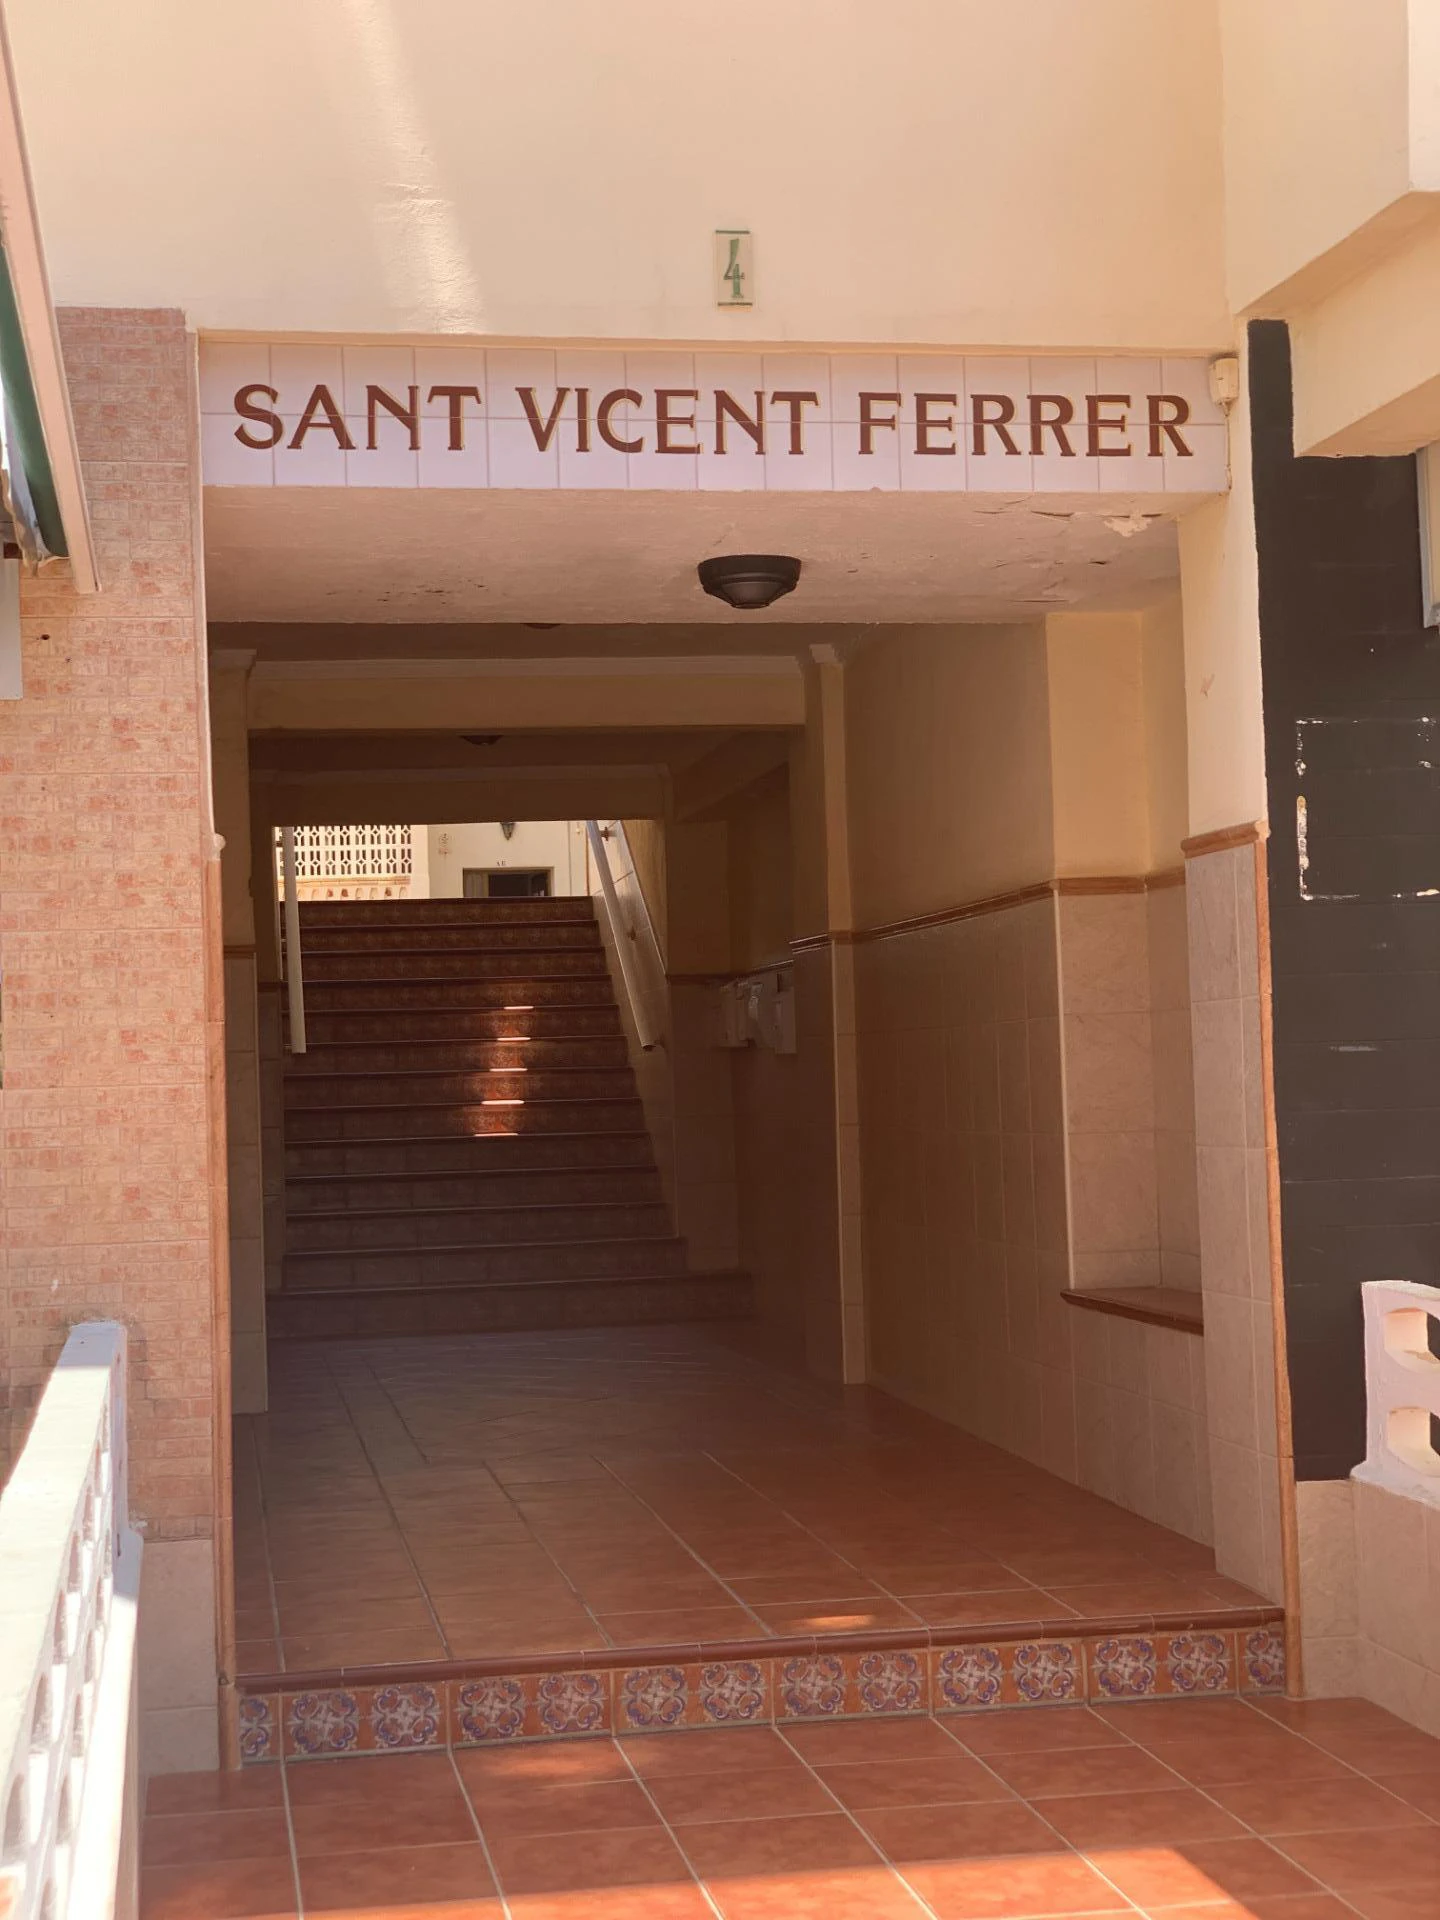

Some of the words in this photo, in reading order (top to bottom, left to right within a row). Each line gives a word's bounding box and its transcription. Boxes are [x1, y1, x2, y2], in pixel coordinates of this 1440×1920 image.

[723, 238, 745, 298] 4
[233, 383, 482, 450] SANT
[515, 386, 819, 455] VICENT
[858, 391, 1193, 457] FERRER
